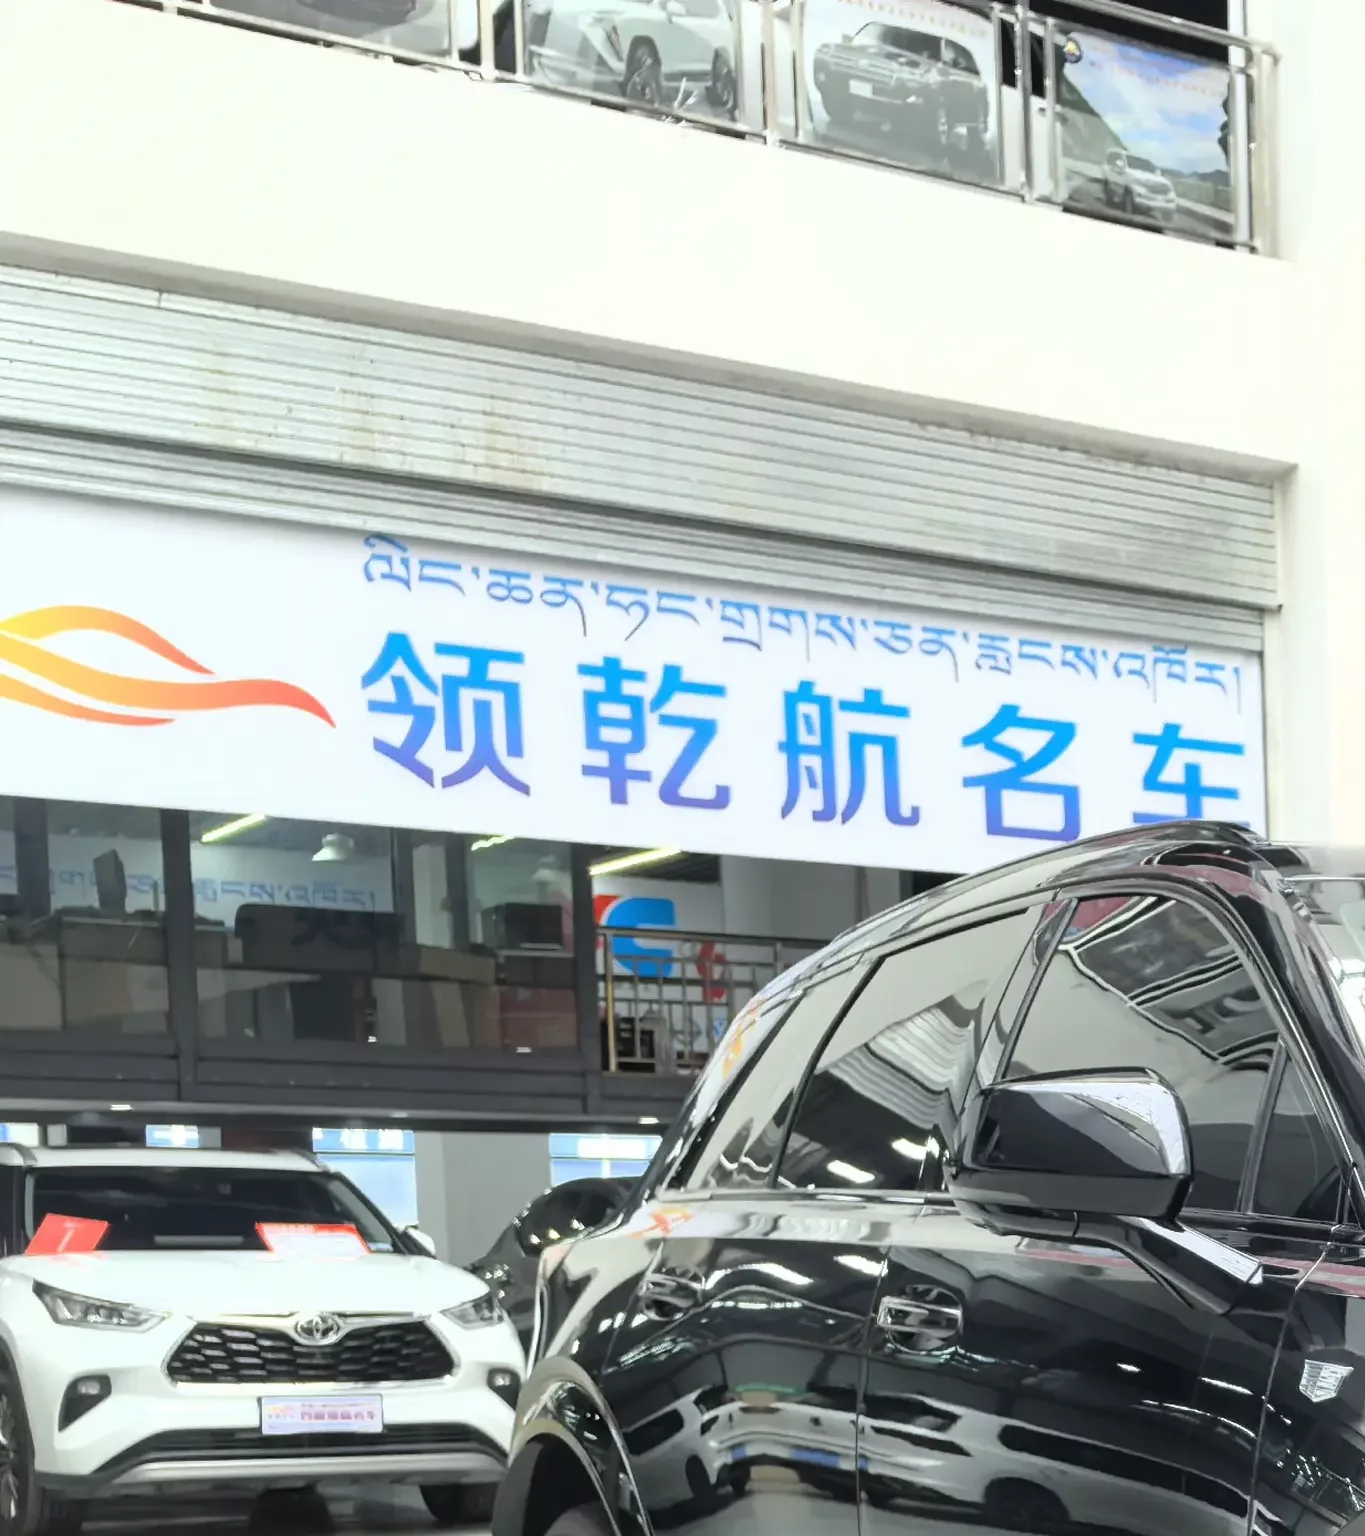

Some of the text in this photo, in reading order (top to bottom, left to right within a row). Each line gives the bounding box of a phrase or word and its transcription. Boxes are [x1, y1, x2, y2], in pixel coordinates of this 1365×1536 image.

[361, 631, 1250, 842] 领乾航名车
